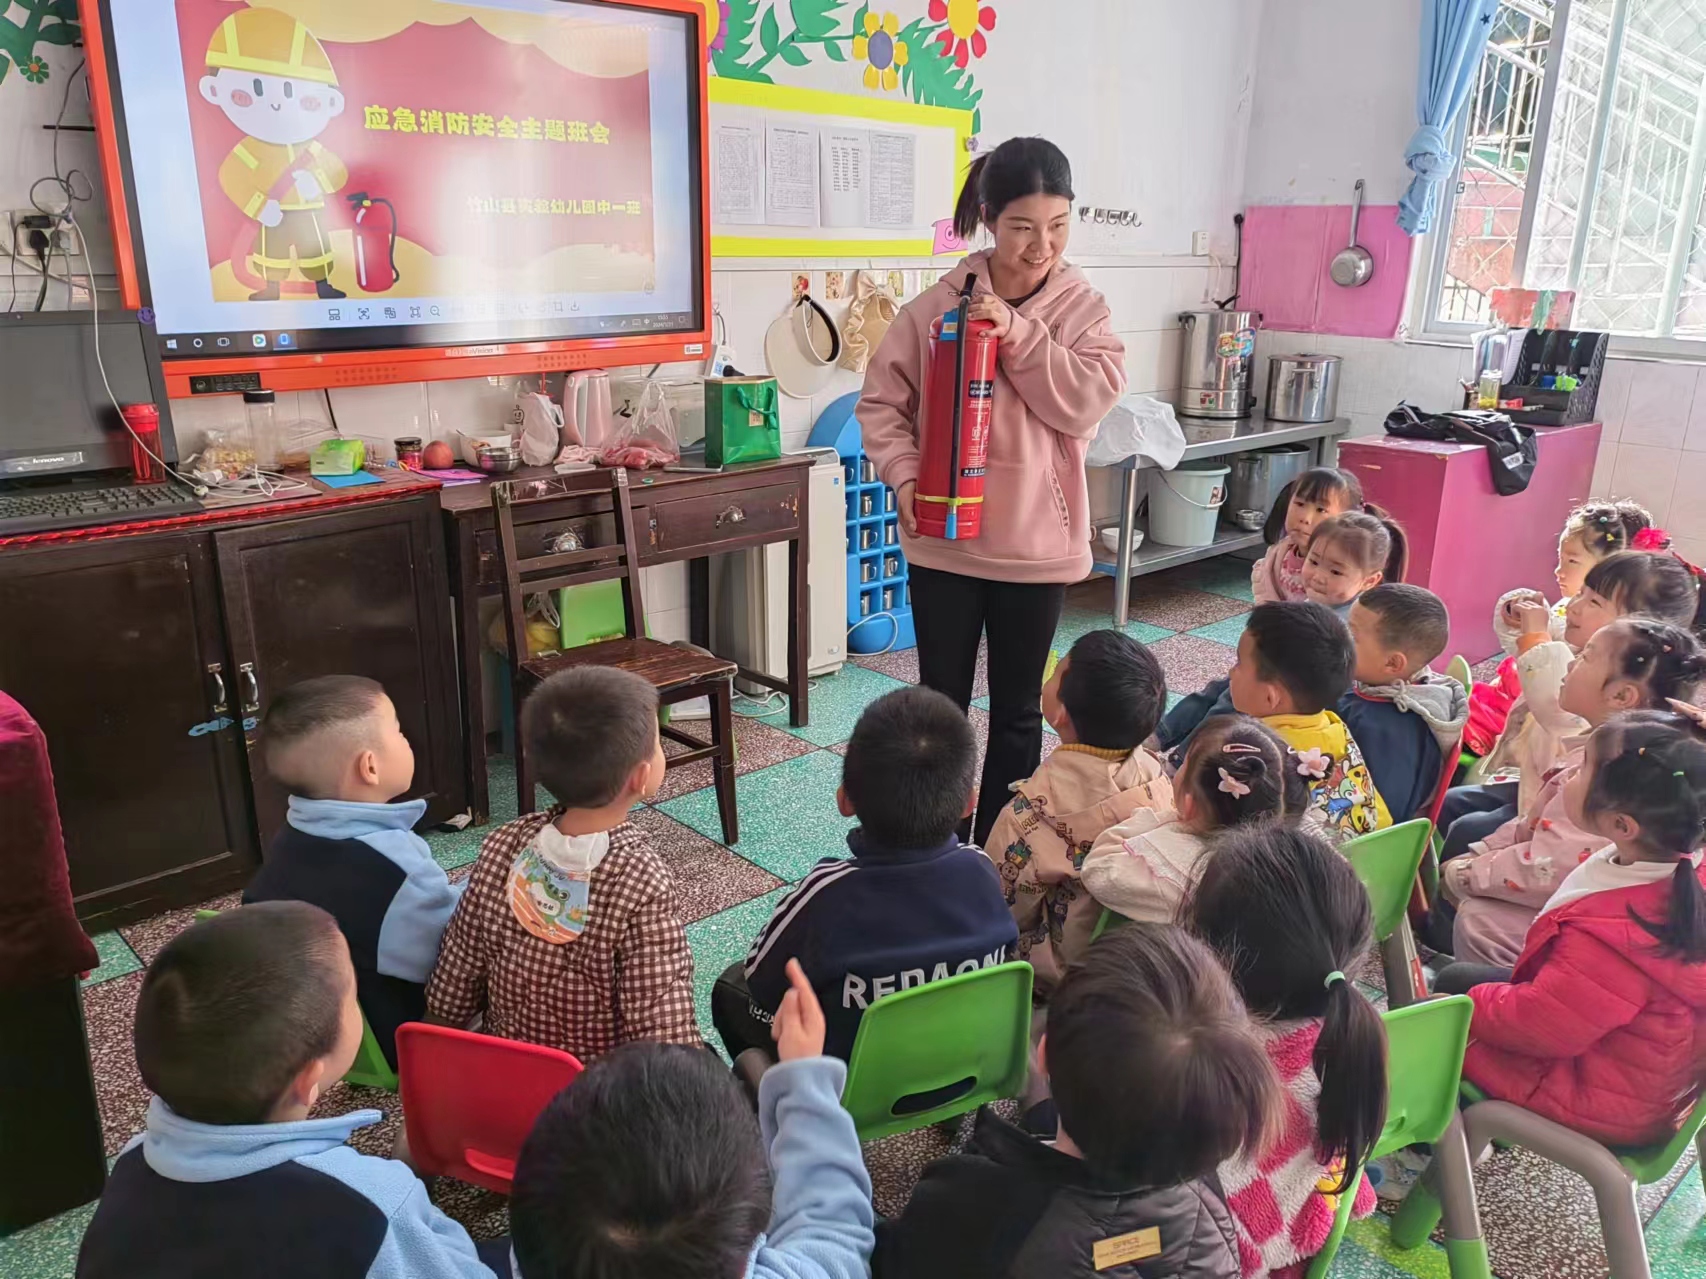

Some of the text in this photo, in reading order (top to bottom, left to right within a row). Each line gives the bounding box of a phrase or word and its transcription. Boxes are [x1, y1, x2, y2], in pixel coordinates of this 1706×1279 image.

[363, 104, 611, 145] 应急消防安全主题班会
